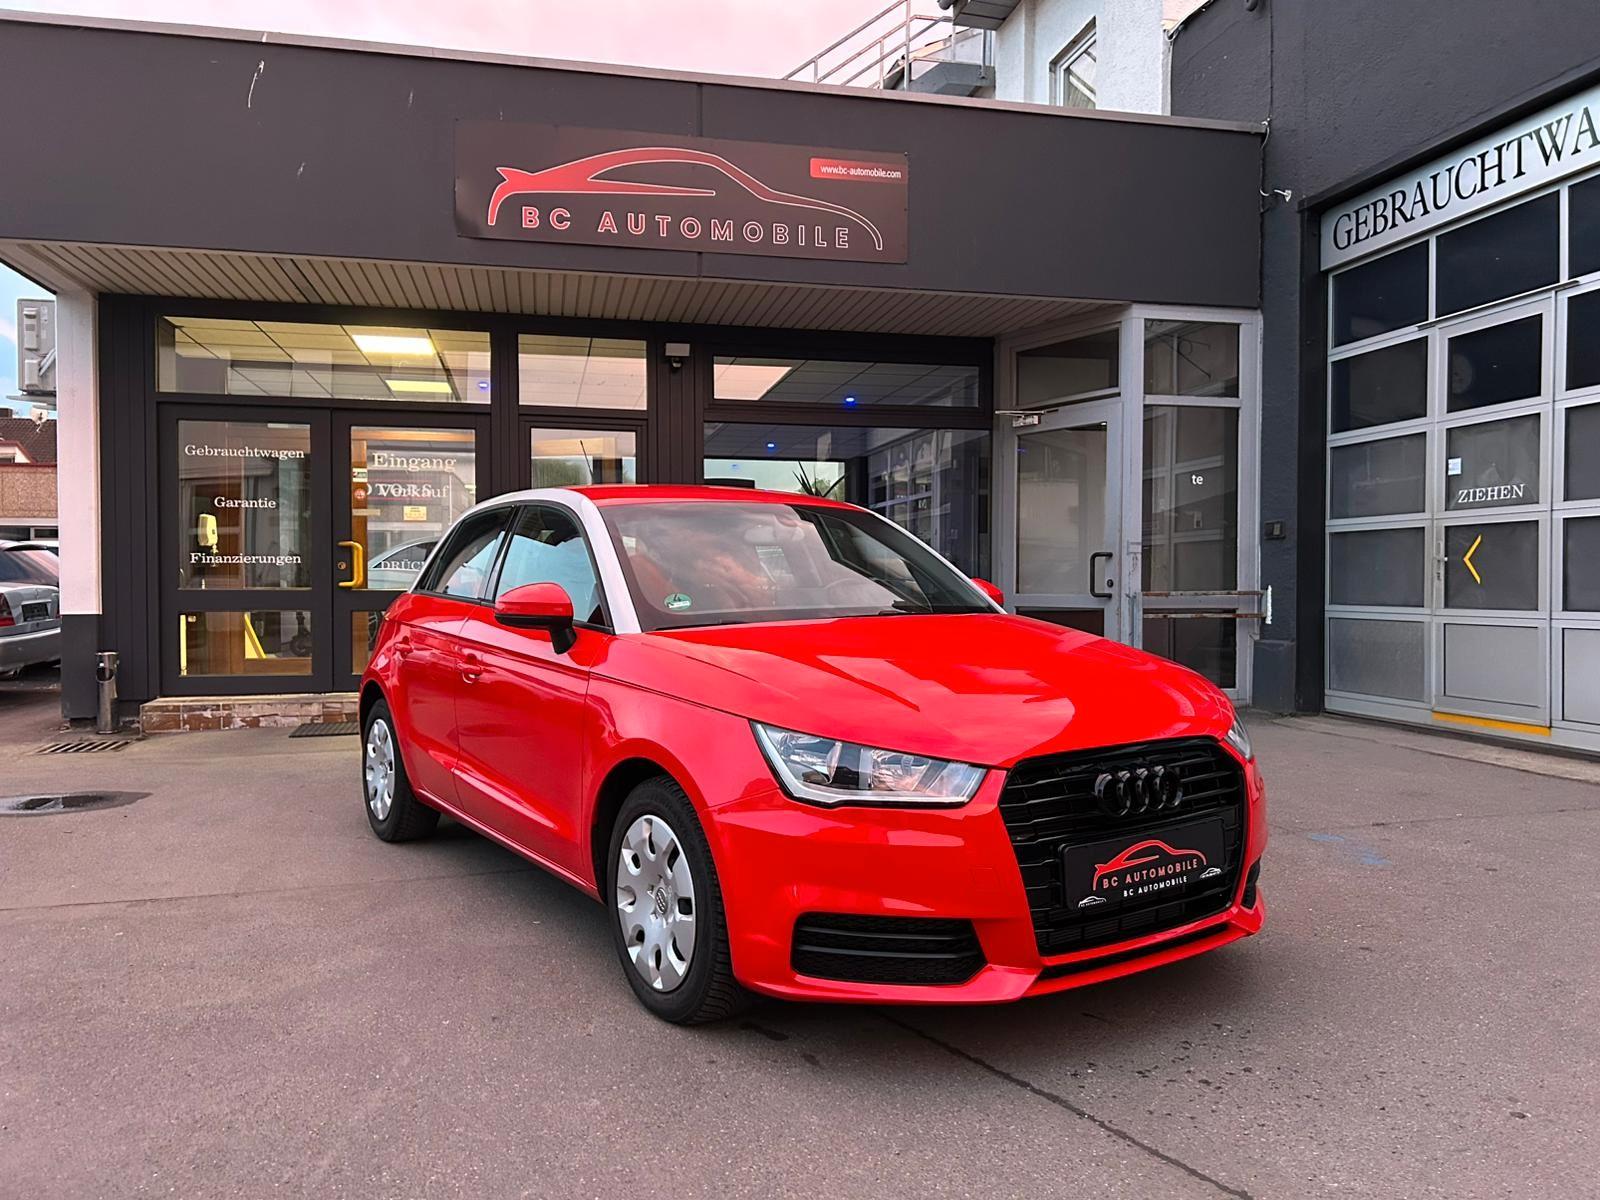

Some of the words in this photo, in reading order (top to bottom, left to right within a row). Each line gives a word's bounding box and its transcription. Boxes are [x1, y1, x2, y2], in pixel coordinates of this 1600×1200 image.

[820, 165, 902, 178] www.bc-automobile.com
[1333, 106, 1600, 250] GEBRAUCHTWA
[521, 206, 571, 230] BC
[597, 211, 849, 248] AUTOMOBILE
[185, 444, 305, 460] Gebrauchtwagen
[372, 452, 456, 473] Eingang
[1191, 474, 1204, 485] te
[1458, 484, 1525, 503] ZIEHEN
[214, 496, 276, 509] Garantie
[190, 552, 301, 566] Finanzierungen
[381, 558, 426, 571] DRÜC
[1102, 876, 1119, 889] BC
[1125, 858, 1199, 884] AUTOMOBILE
[1123, 888, 1134, 897] BC
[1138, 875, 1188, 894] AUTOMOBILE
